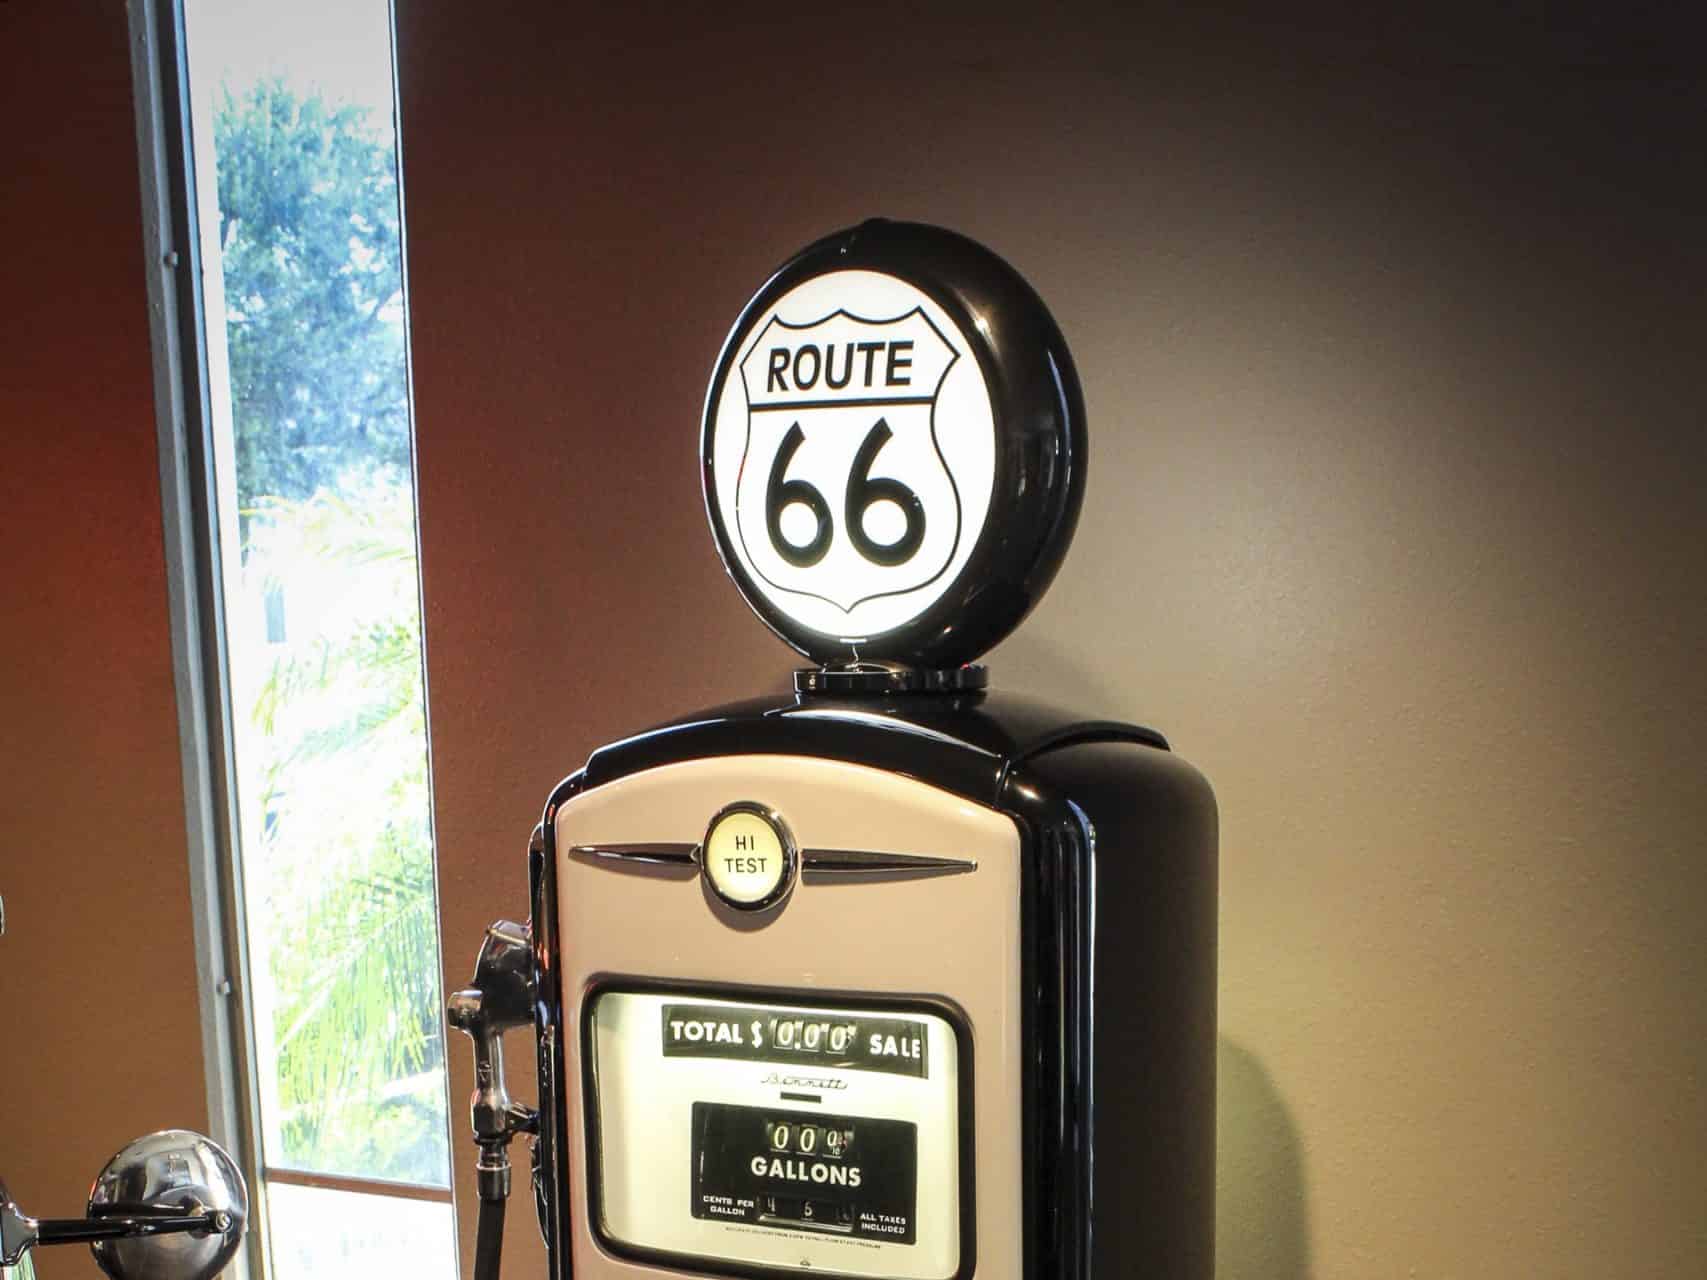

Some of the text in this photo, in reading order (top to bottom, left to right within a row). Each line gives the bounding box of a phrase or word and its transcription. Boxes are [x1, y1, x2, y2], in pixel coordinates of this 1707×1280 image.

[767, 341, 914, 392] ROUTE
[765, 417, 926, 568] 66
[735, 835, 755, 851] HI
[724, 858, 767, 874] TEST
[670, 1020, 743, 1044] TOTAL
[869, 1034, 921, 1058] SALE
[751, 1156, 861, 1186] GALLONS
[703, 1195, 754, 1208] CENTS PER
[710, 1205, 745, 1216] GALLON
[859, 1213, 876, 1222] ALL
[880, 1215, 906, 1225] TAXES
[861, 1223, 905, 1235] INCLUDED
